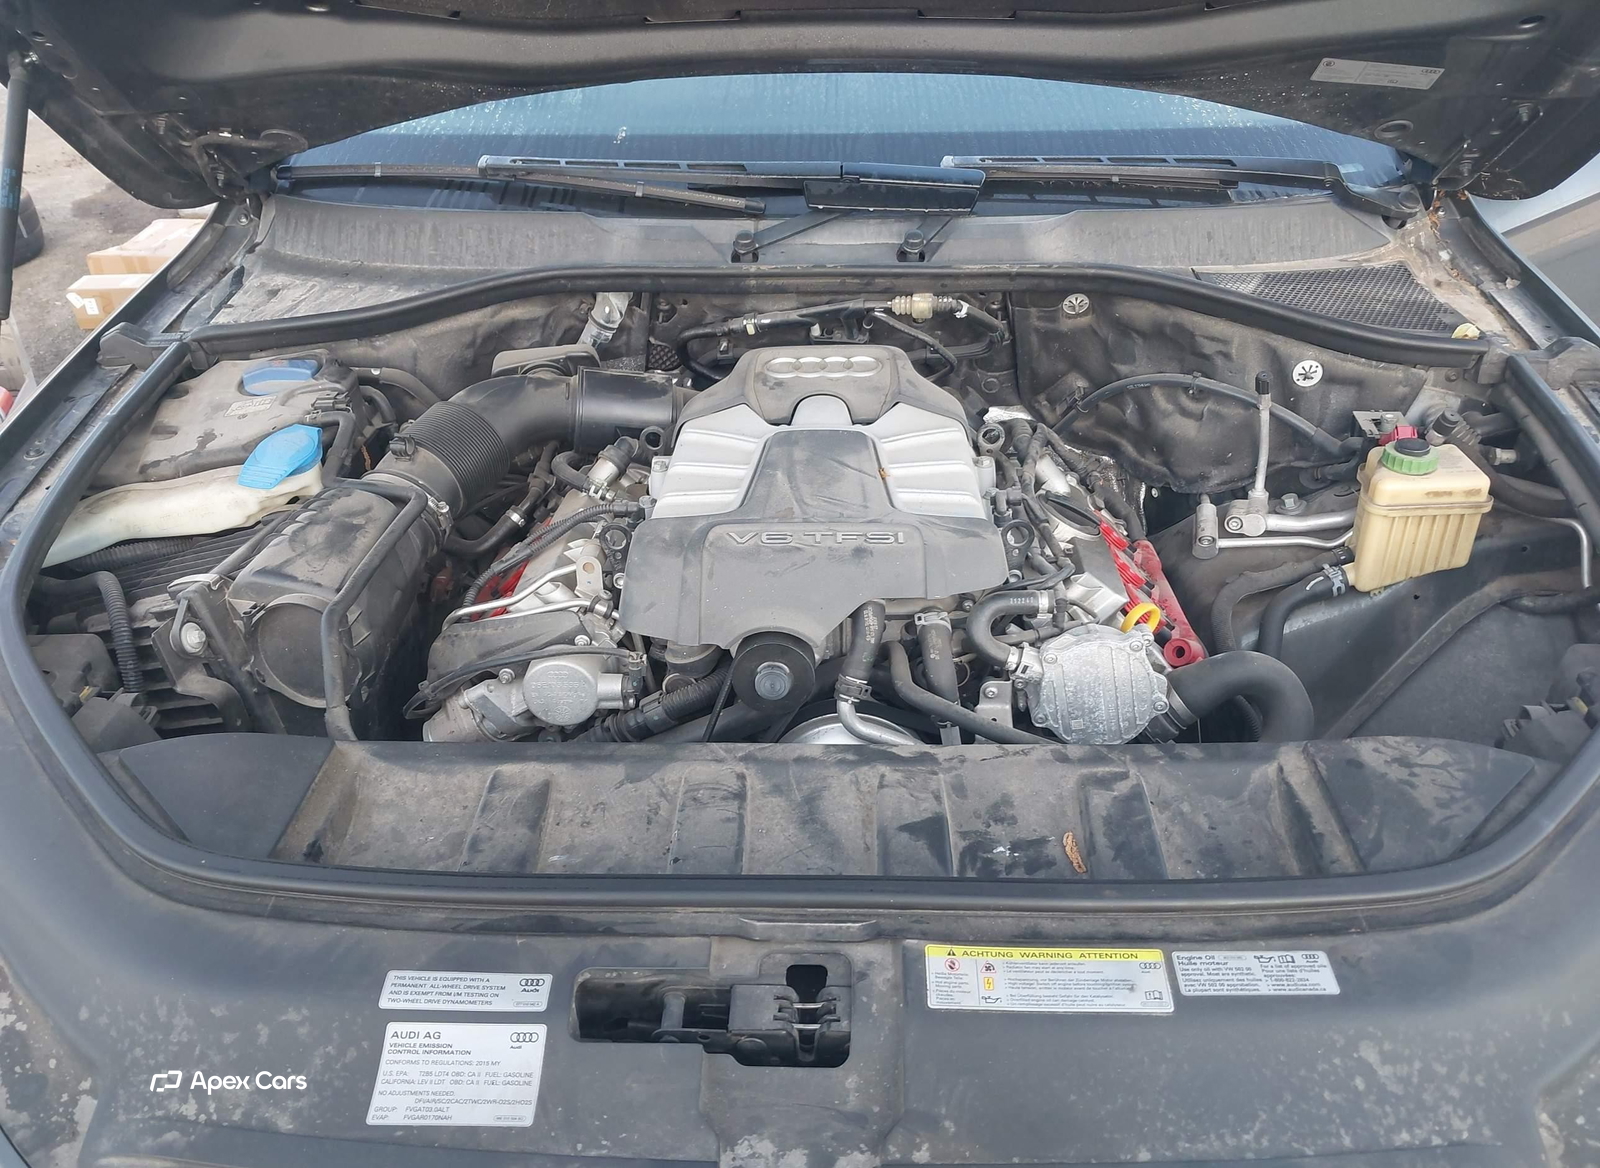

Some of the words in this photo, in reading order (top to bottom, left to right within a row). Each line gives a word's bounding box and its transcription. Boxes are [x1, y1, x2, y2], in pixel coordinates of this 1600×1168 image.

[727, 532, 793, 544] V6
[804, 532, 905, 544] TFSI
[391, 1031, 420, 1039] AUDI
[423, 1031, 441, 1040] AG
